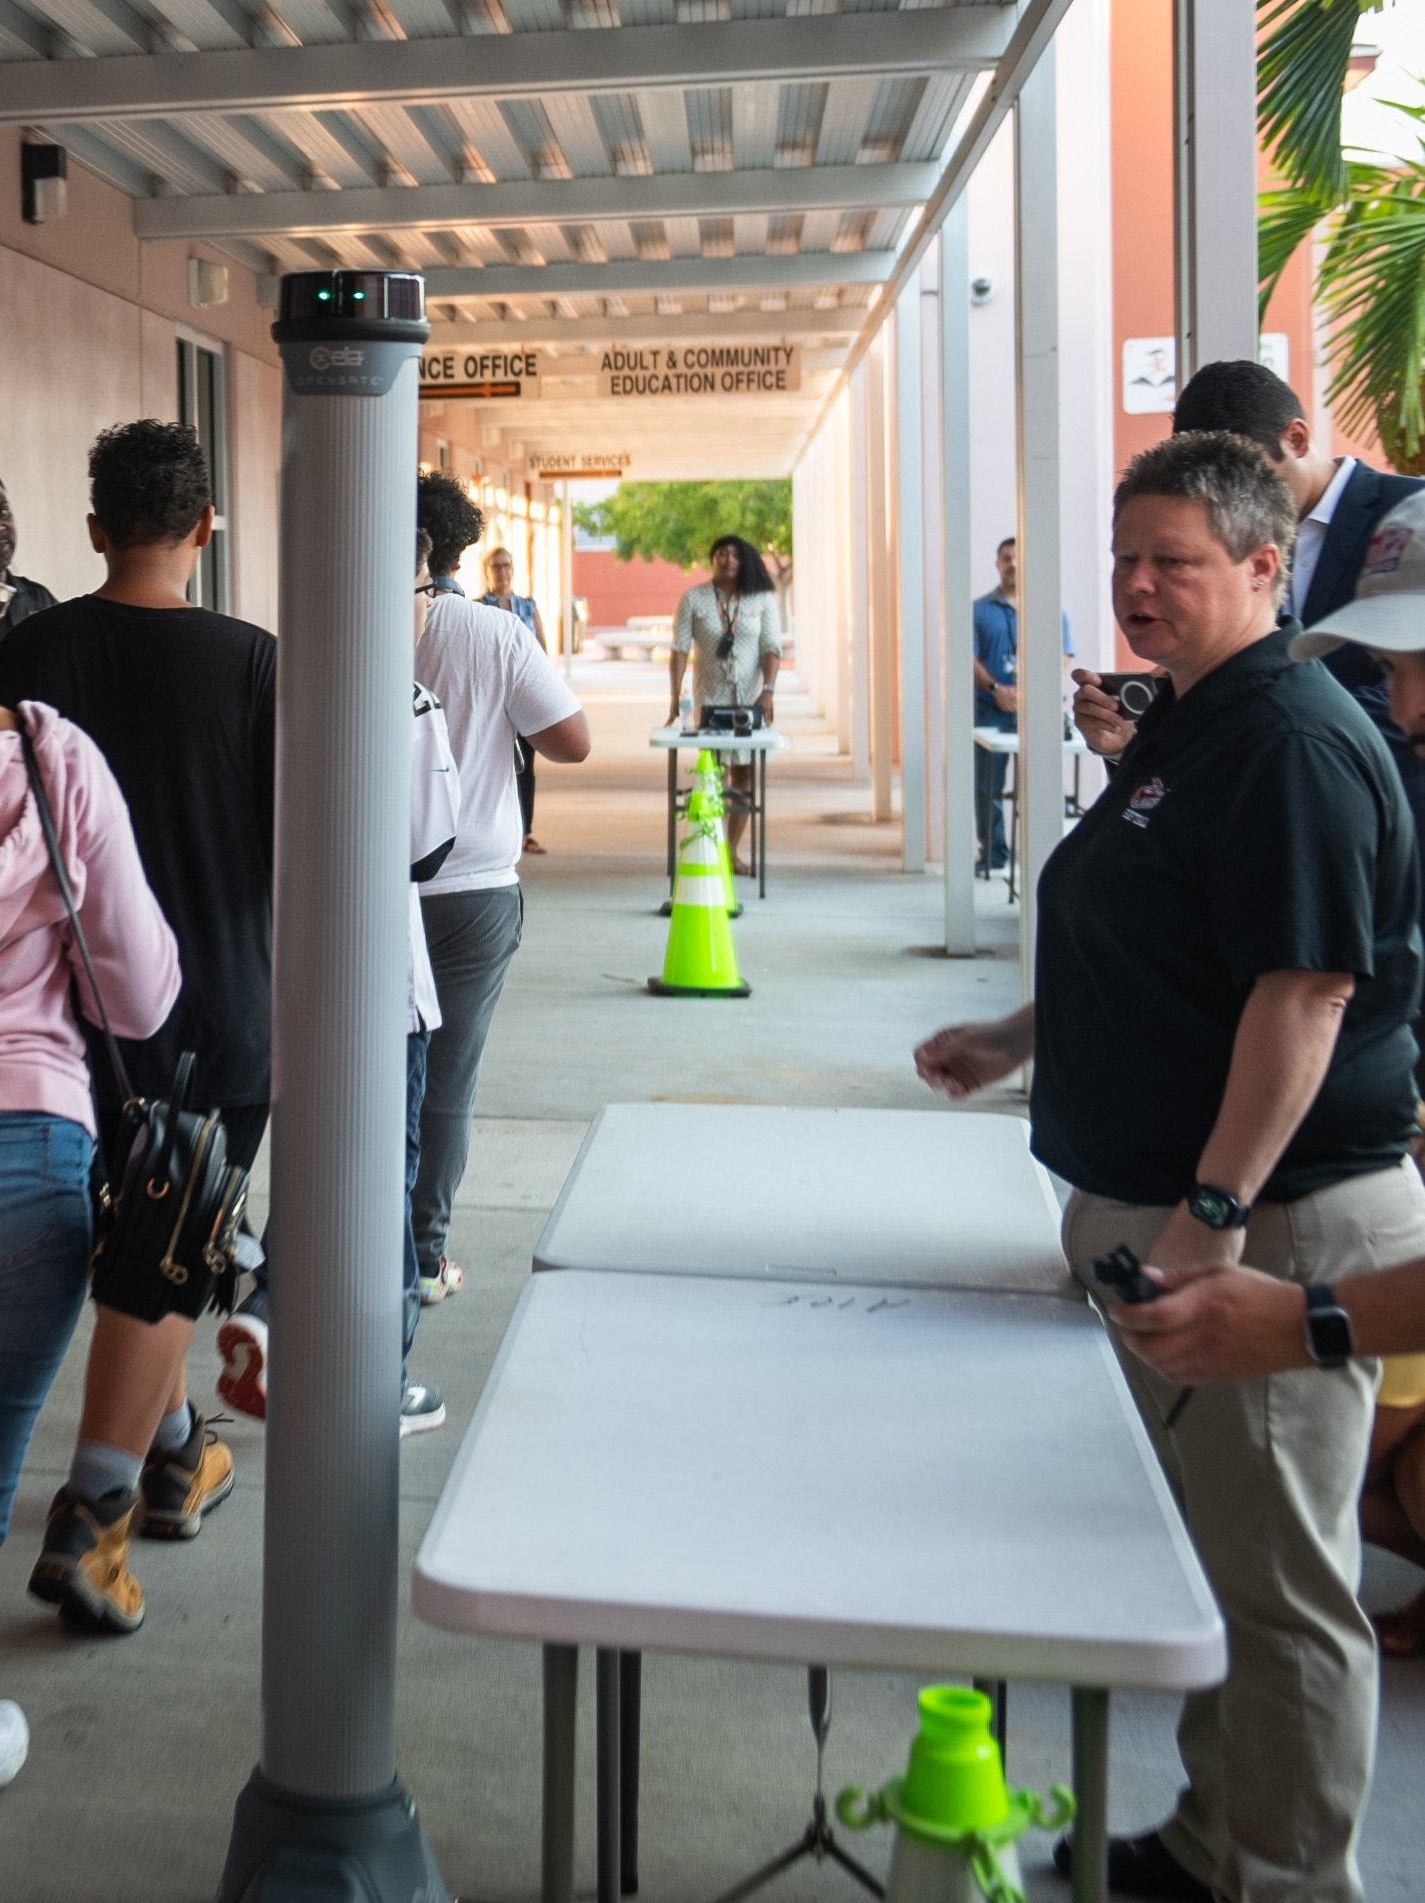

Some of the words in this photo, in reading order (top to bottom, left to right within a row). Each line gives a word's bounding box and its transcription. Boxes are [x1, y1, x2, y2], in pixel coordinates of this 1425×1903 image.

[464, 354, 537, 378] OFFICE
[601, 350, 660, 371] ADULT
[666, 351, 677, 370] &
[683, 346, 794, 369] COMMUNITY
[611, 372, 715, 395] EDUCATION
[721, 370, 786, 392] OFFICE
